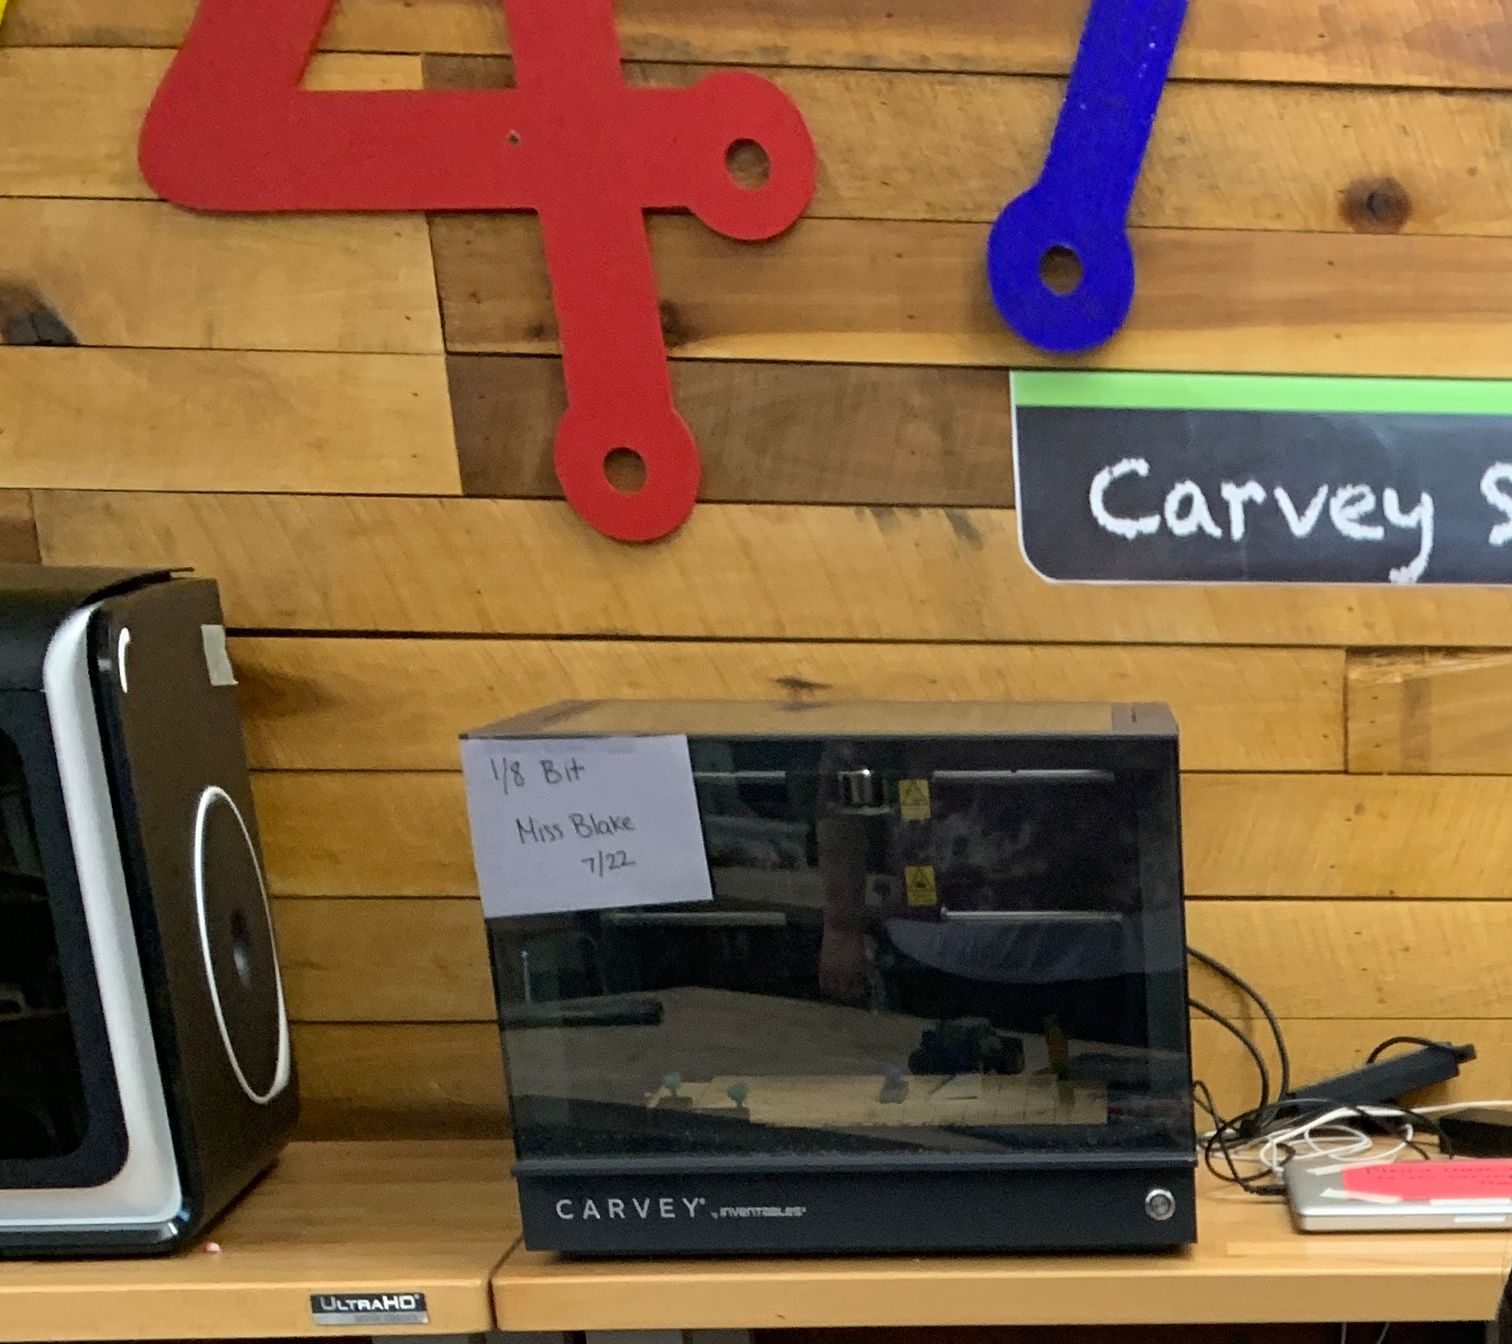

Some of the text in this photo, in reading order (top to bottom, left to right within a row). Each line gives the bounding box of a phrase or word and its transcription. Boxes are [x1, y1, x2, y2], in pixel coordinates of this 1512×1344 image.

[1088, 457, 1434, 583] Carvey
[490, 757, 585, 795] 1/8 Bit
[516, 812, 636, 844] Miss Blake
[580, 849, 636, 877] 7/22
[555, 1198, 701, 1219] CARVEY
